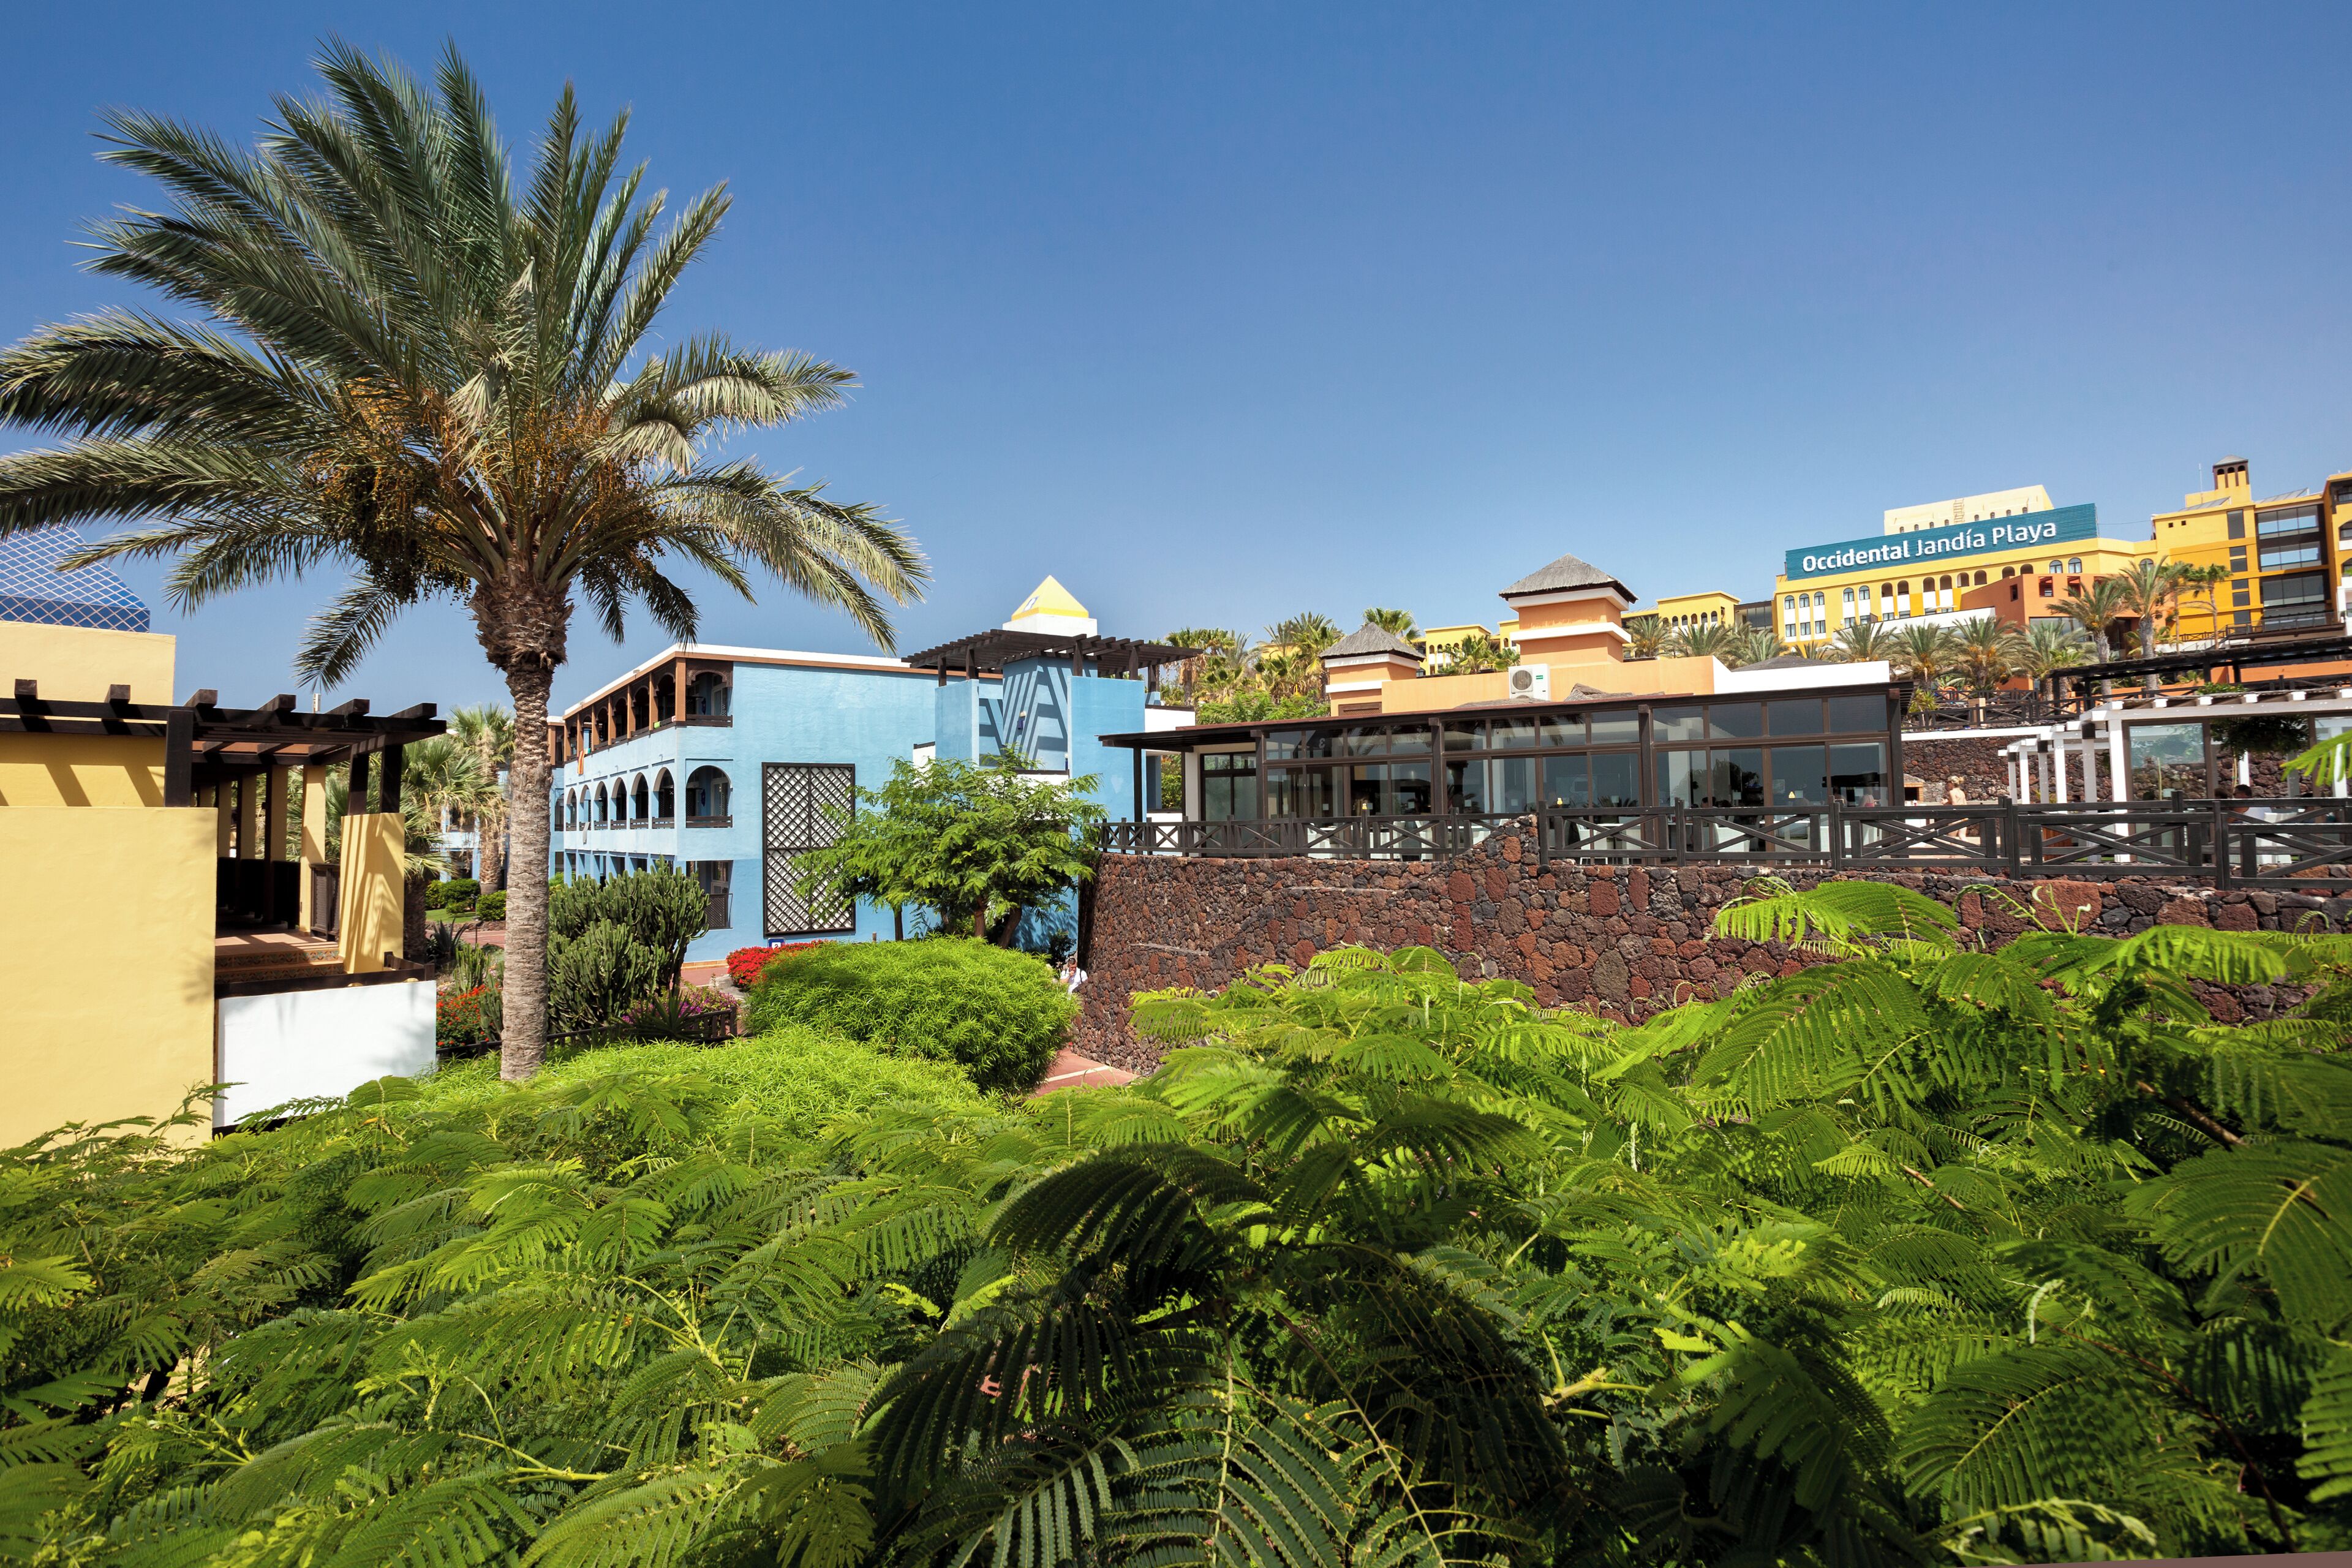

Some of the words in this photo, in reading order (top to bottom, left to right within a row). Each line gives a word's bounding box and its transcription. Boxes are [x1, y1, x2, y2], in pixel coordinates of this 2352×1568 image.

[1803, 540, 1910, 572] Occidental
[1915, 529, 1985, 556] Jandía
[1992, 522, 2056, 545] Playa
